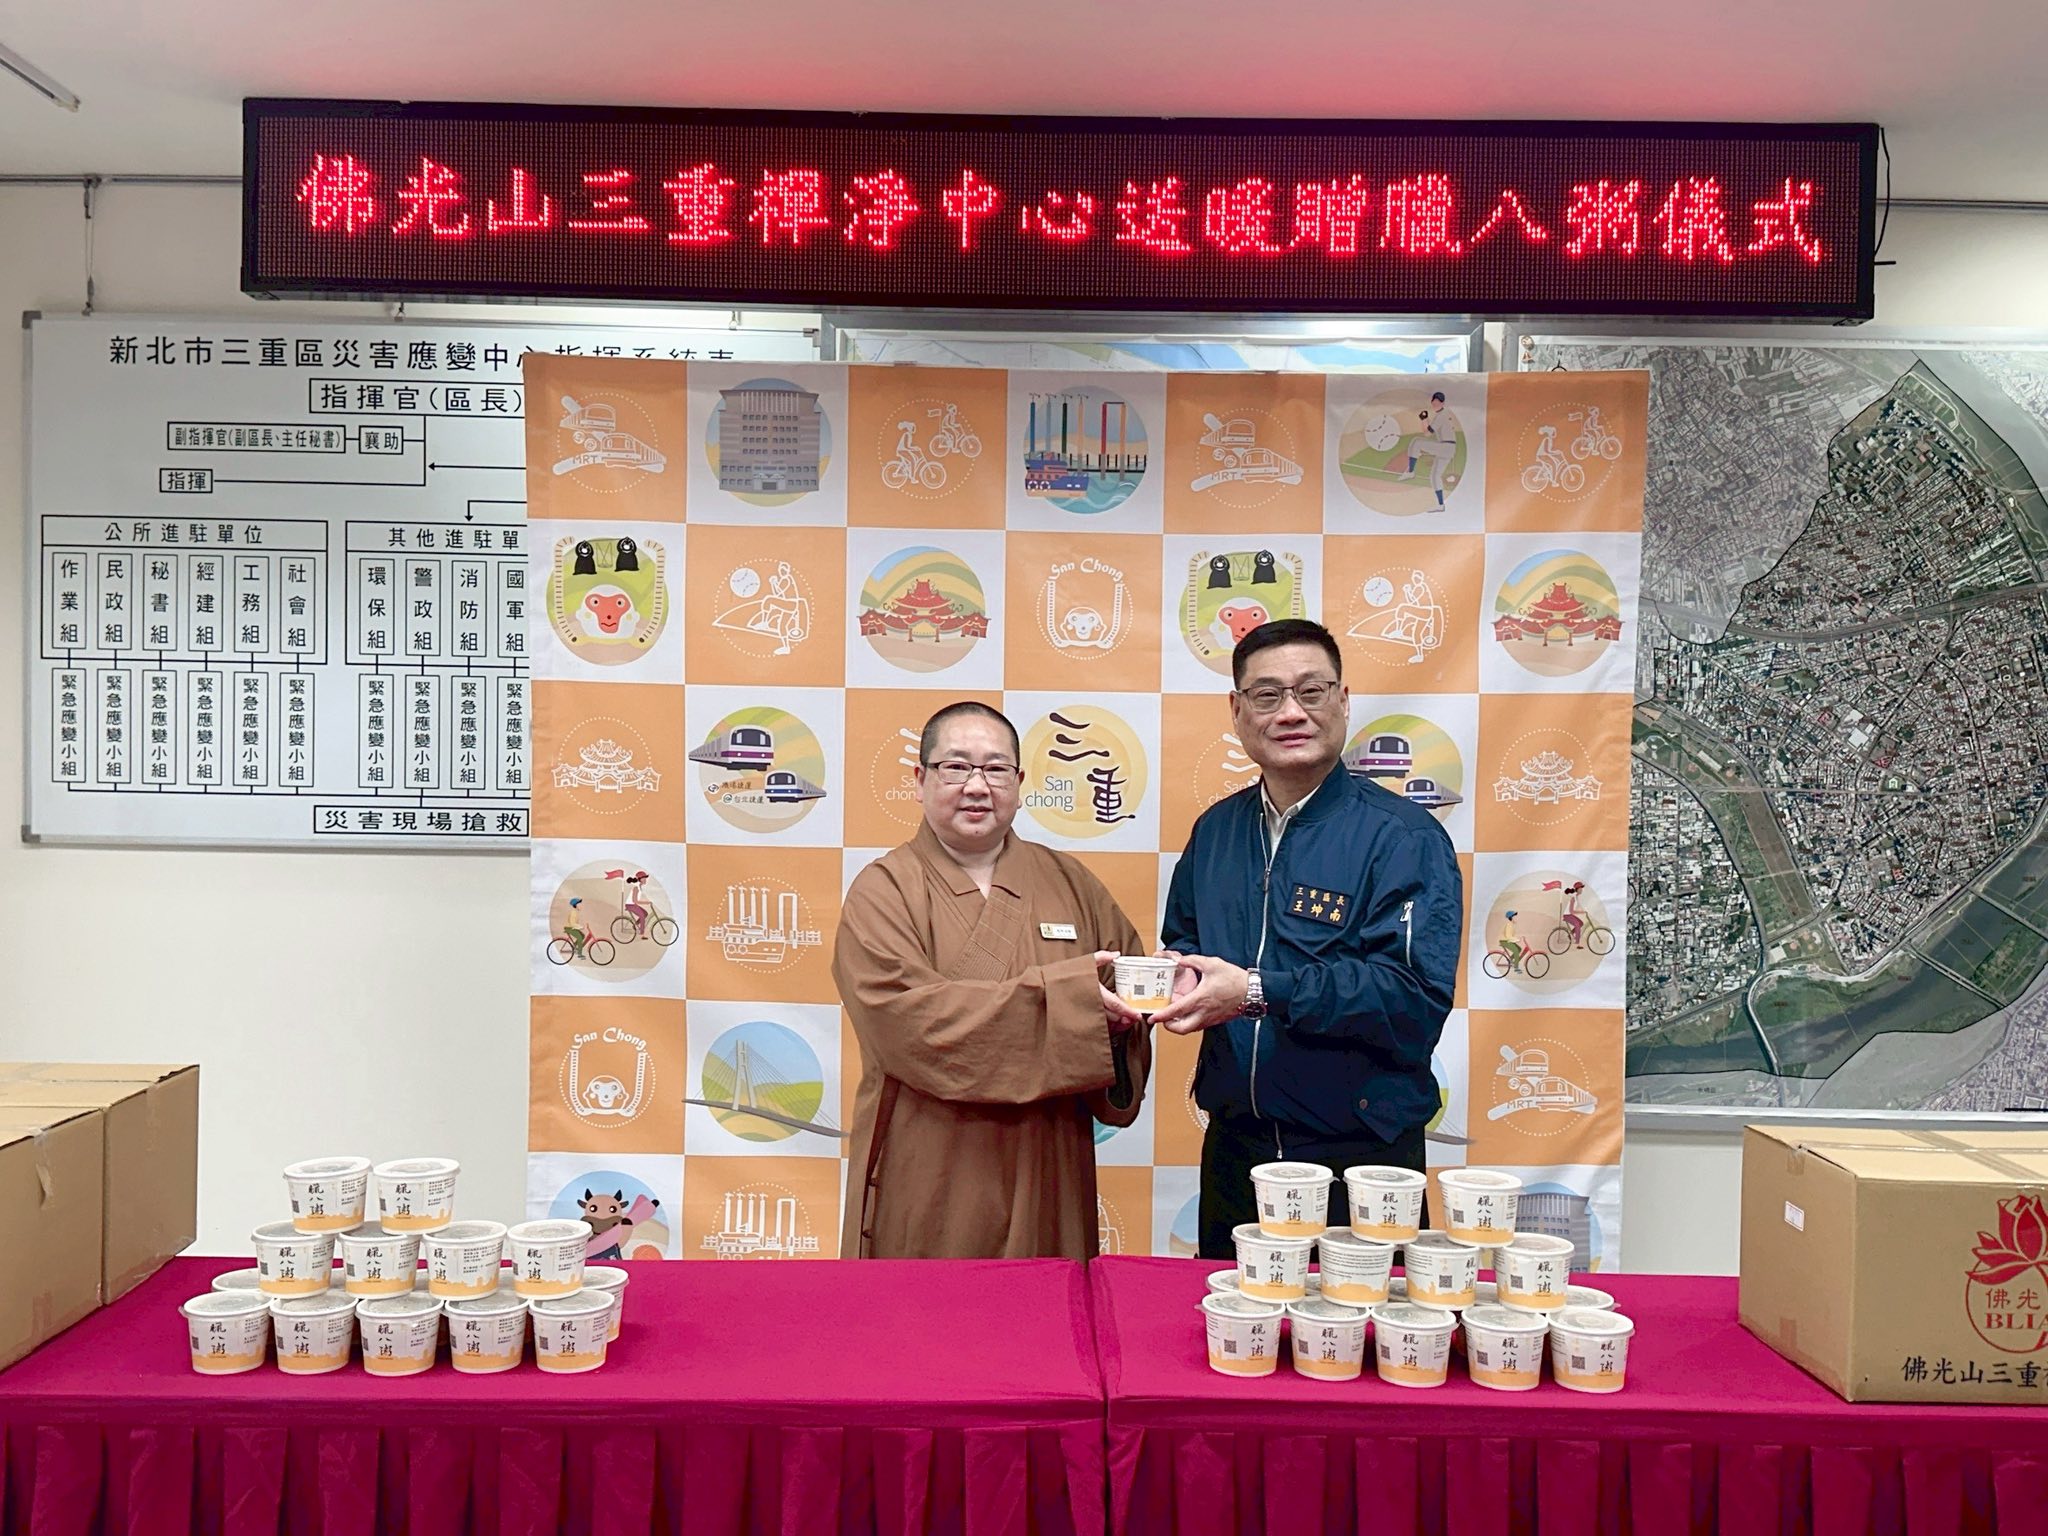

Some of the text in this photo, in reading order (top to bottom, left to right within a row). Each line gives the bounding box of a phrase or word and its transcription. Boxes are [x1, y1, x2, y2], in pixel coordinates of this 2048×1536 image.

[167, 472, 206, 490] 指揮
[364, 431, 400, 452] 襄助
[572, 454, 598, 465] MRT
[1211, 470, 1238, 481] MRT
[104, 522, 263, 544] 公所進駐單位
[388, 527, 521, 550] 其他進駐單
[1048, 557, 1123, 582] San Chong
[60, 560, 79, 643] 作業組
[105, 560, 124, 643] 民政組
[150, 561, 169, 644] 秘書組
[196, 562, 215, 645] 經建組
[242, 564, 261, 644] 工務組
[288, 564, 306, 647] 社會組
[368, 567, 386, 649] 環保組
[414, 567, 433, 650] 警政組
[460, 569, 479, 651] 消防組
[506, 570, 525, 652] 國軍組
[61, 675, 77, 776] 緊急應變小組
[106, 675, 122, 777] 緊急應變小組
[151, 676, 168, 778] 緊急應變小組
[197, 677, 213, 779] 緊急應變小組
[243, 678, 259, 780] 緊急應變小組
[288, 679, 305, 781] 緊急應變小組
[368, 680, 384, 782] 緊急應變小組
[414, 681, 431, 782] 緊急應變小組
[460, 682, 477, 783] 緊急應變小組
[506, 683, 523, 784] 緊急應變小組
[885, 786, 917, 801] chon
[901, 775, 917, 788] Sa
[1024, 792, 1074, 813] chong
[1044, 775, 1074, 792] San
[1048, 711, 1136, 824] 三重
[324, 810, 523, 833] 災害現場搶救
[1293, 900, 1341, 922] 王坤南
[571, 1027, 647, 1051] San Chong
[1506, 1099, 1533, 1110] MRT
[1985, 1288, 2041, 1310] 佛光
[1902, 1356, 2048, 1388] 佛光山三重
